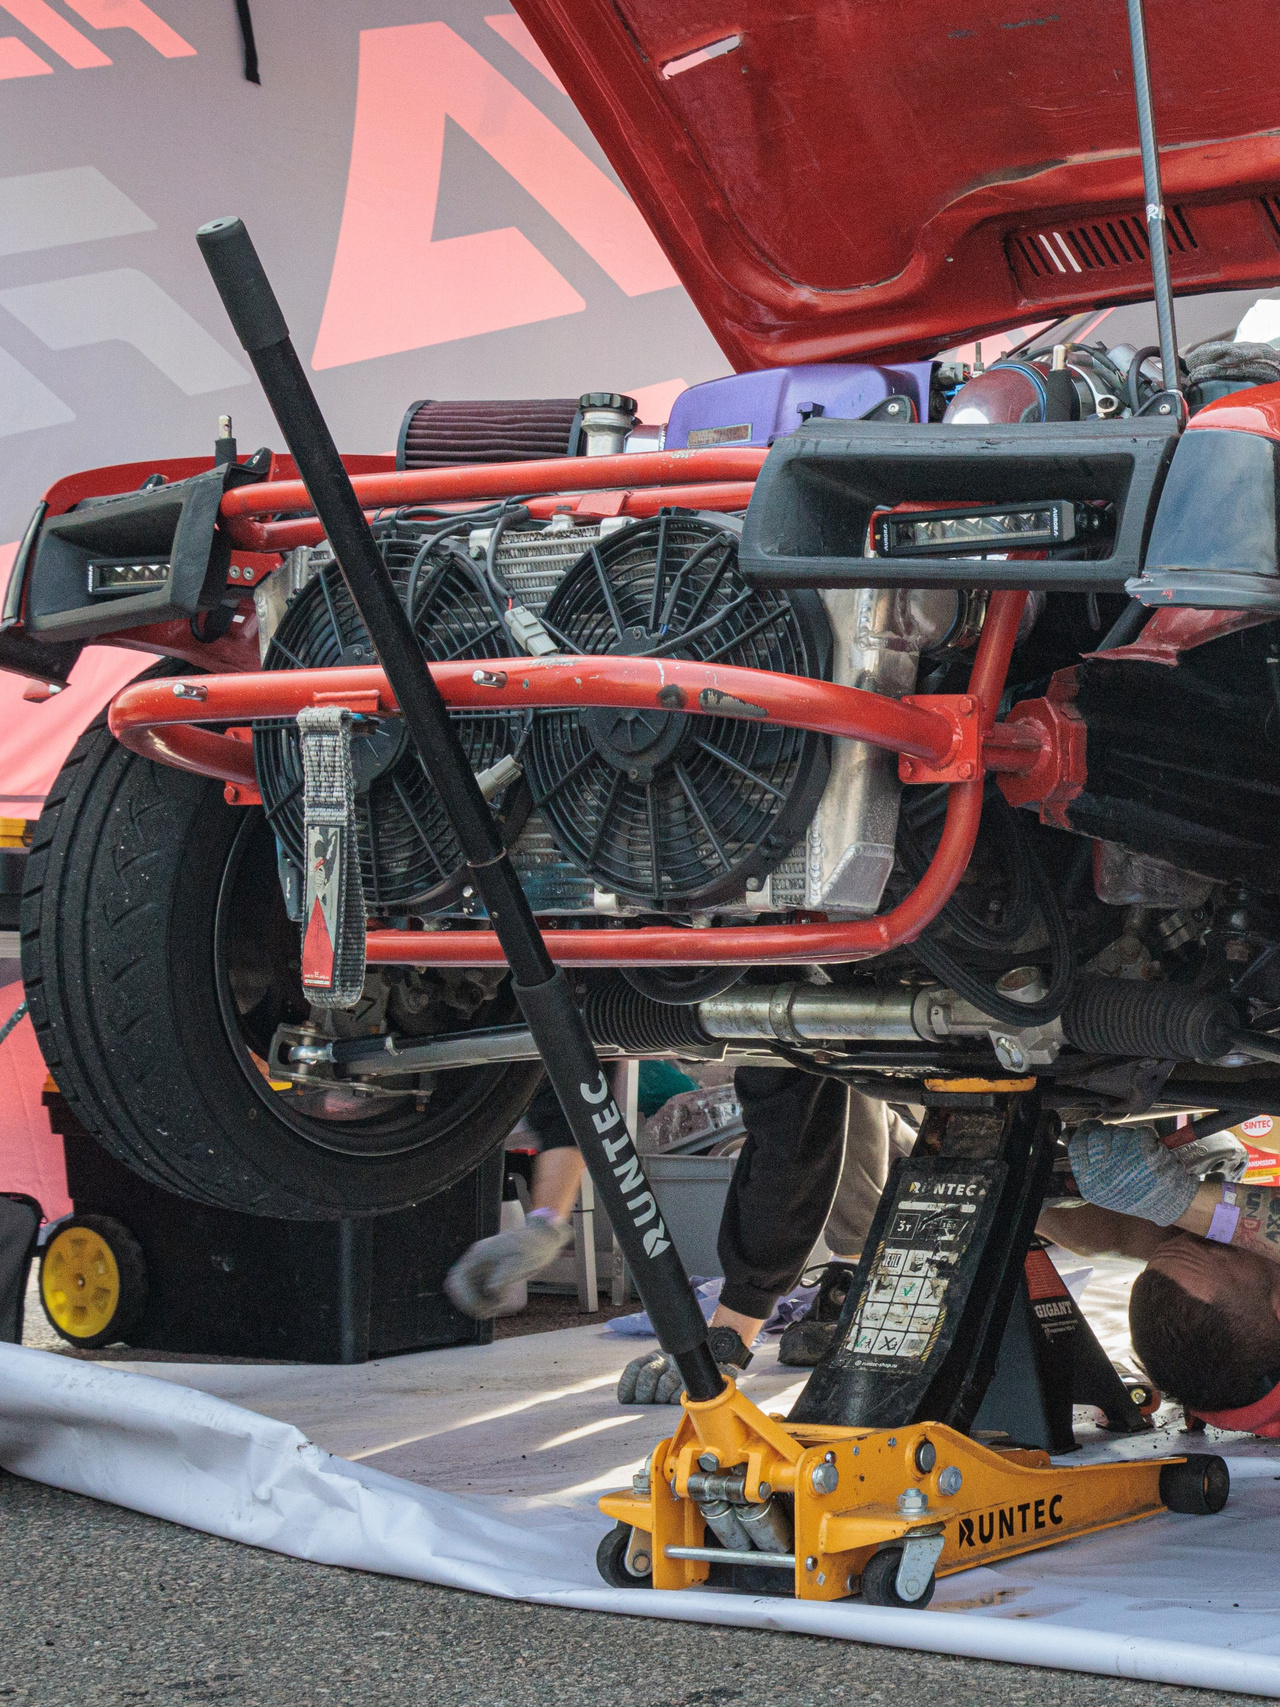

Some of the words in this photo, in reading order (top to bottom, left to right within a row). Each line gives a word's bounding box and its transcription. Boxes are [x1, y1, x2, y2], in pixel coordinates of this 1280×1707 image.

[1243, 1119, 1271, 1130] SINTEC
[581, 1070, 671, 1259] RUNTEC
[1034, 1300, 1073, 1319] GIGANT
[958, 1494, 1065, 1548] RUNTEC
